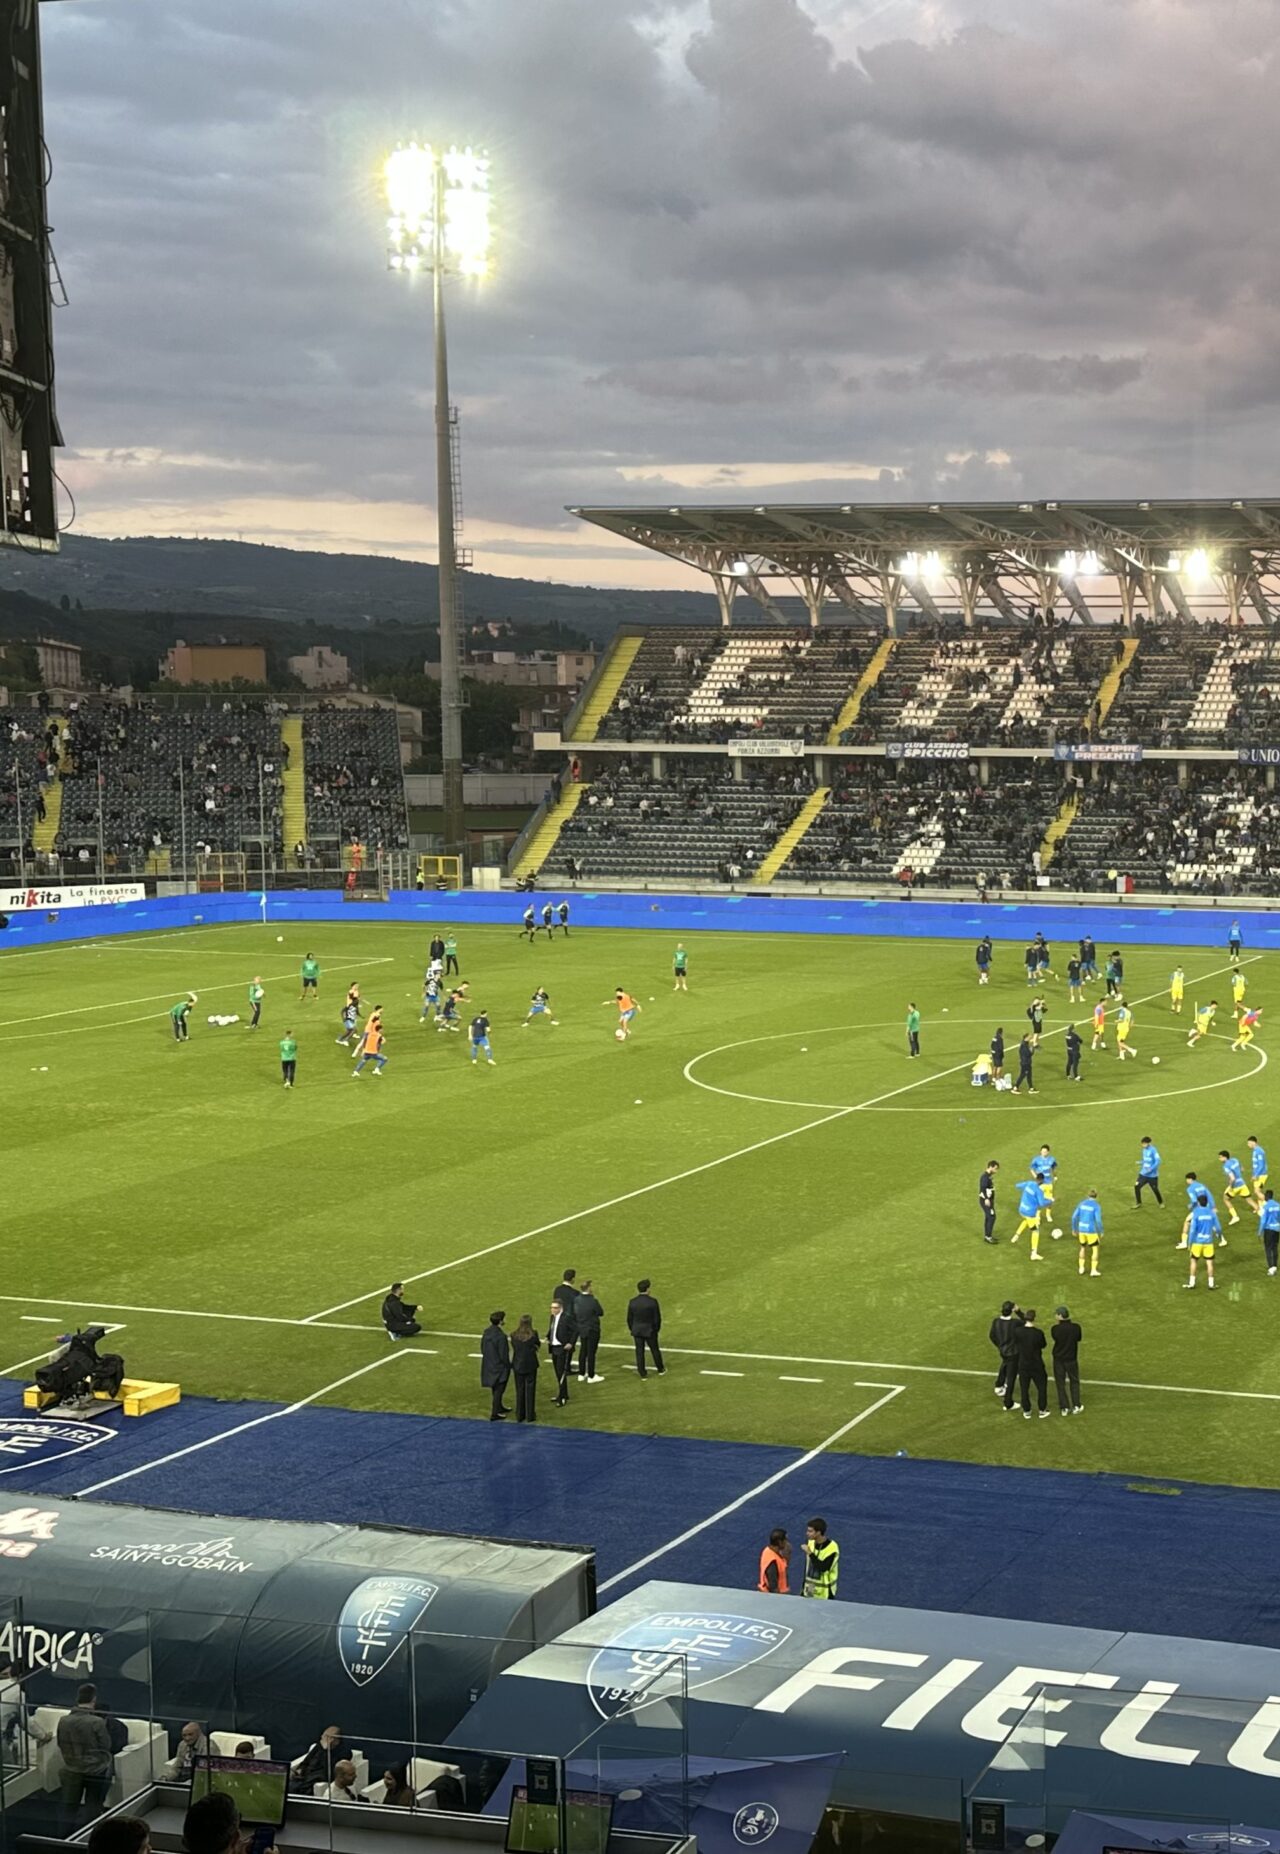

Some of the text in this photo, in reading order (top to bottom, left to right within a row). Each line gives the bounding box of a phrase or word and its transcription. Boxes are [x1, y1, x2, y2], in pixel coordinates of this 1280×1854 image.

[904, 749, 968, 758] SPICCHIO
[10, 889, 62, 907] nikita
[70, 887, 137, 897] La finestra
[90, 1547, 253, 1572] SAINT-GOBAIN
[411, 1585, 431, 1597] F.C.
[650, 1616, 778, 1641] EMPOLI F.C.
[350, 1663, 374, 1675] 1920
[600, 1686, 648, 1704] 1920
